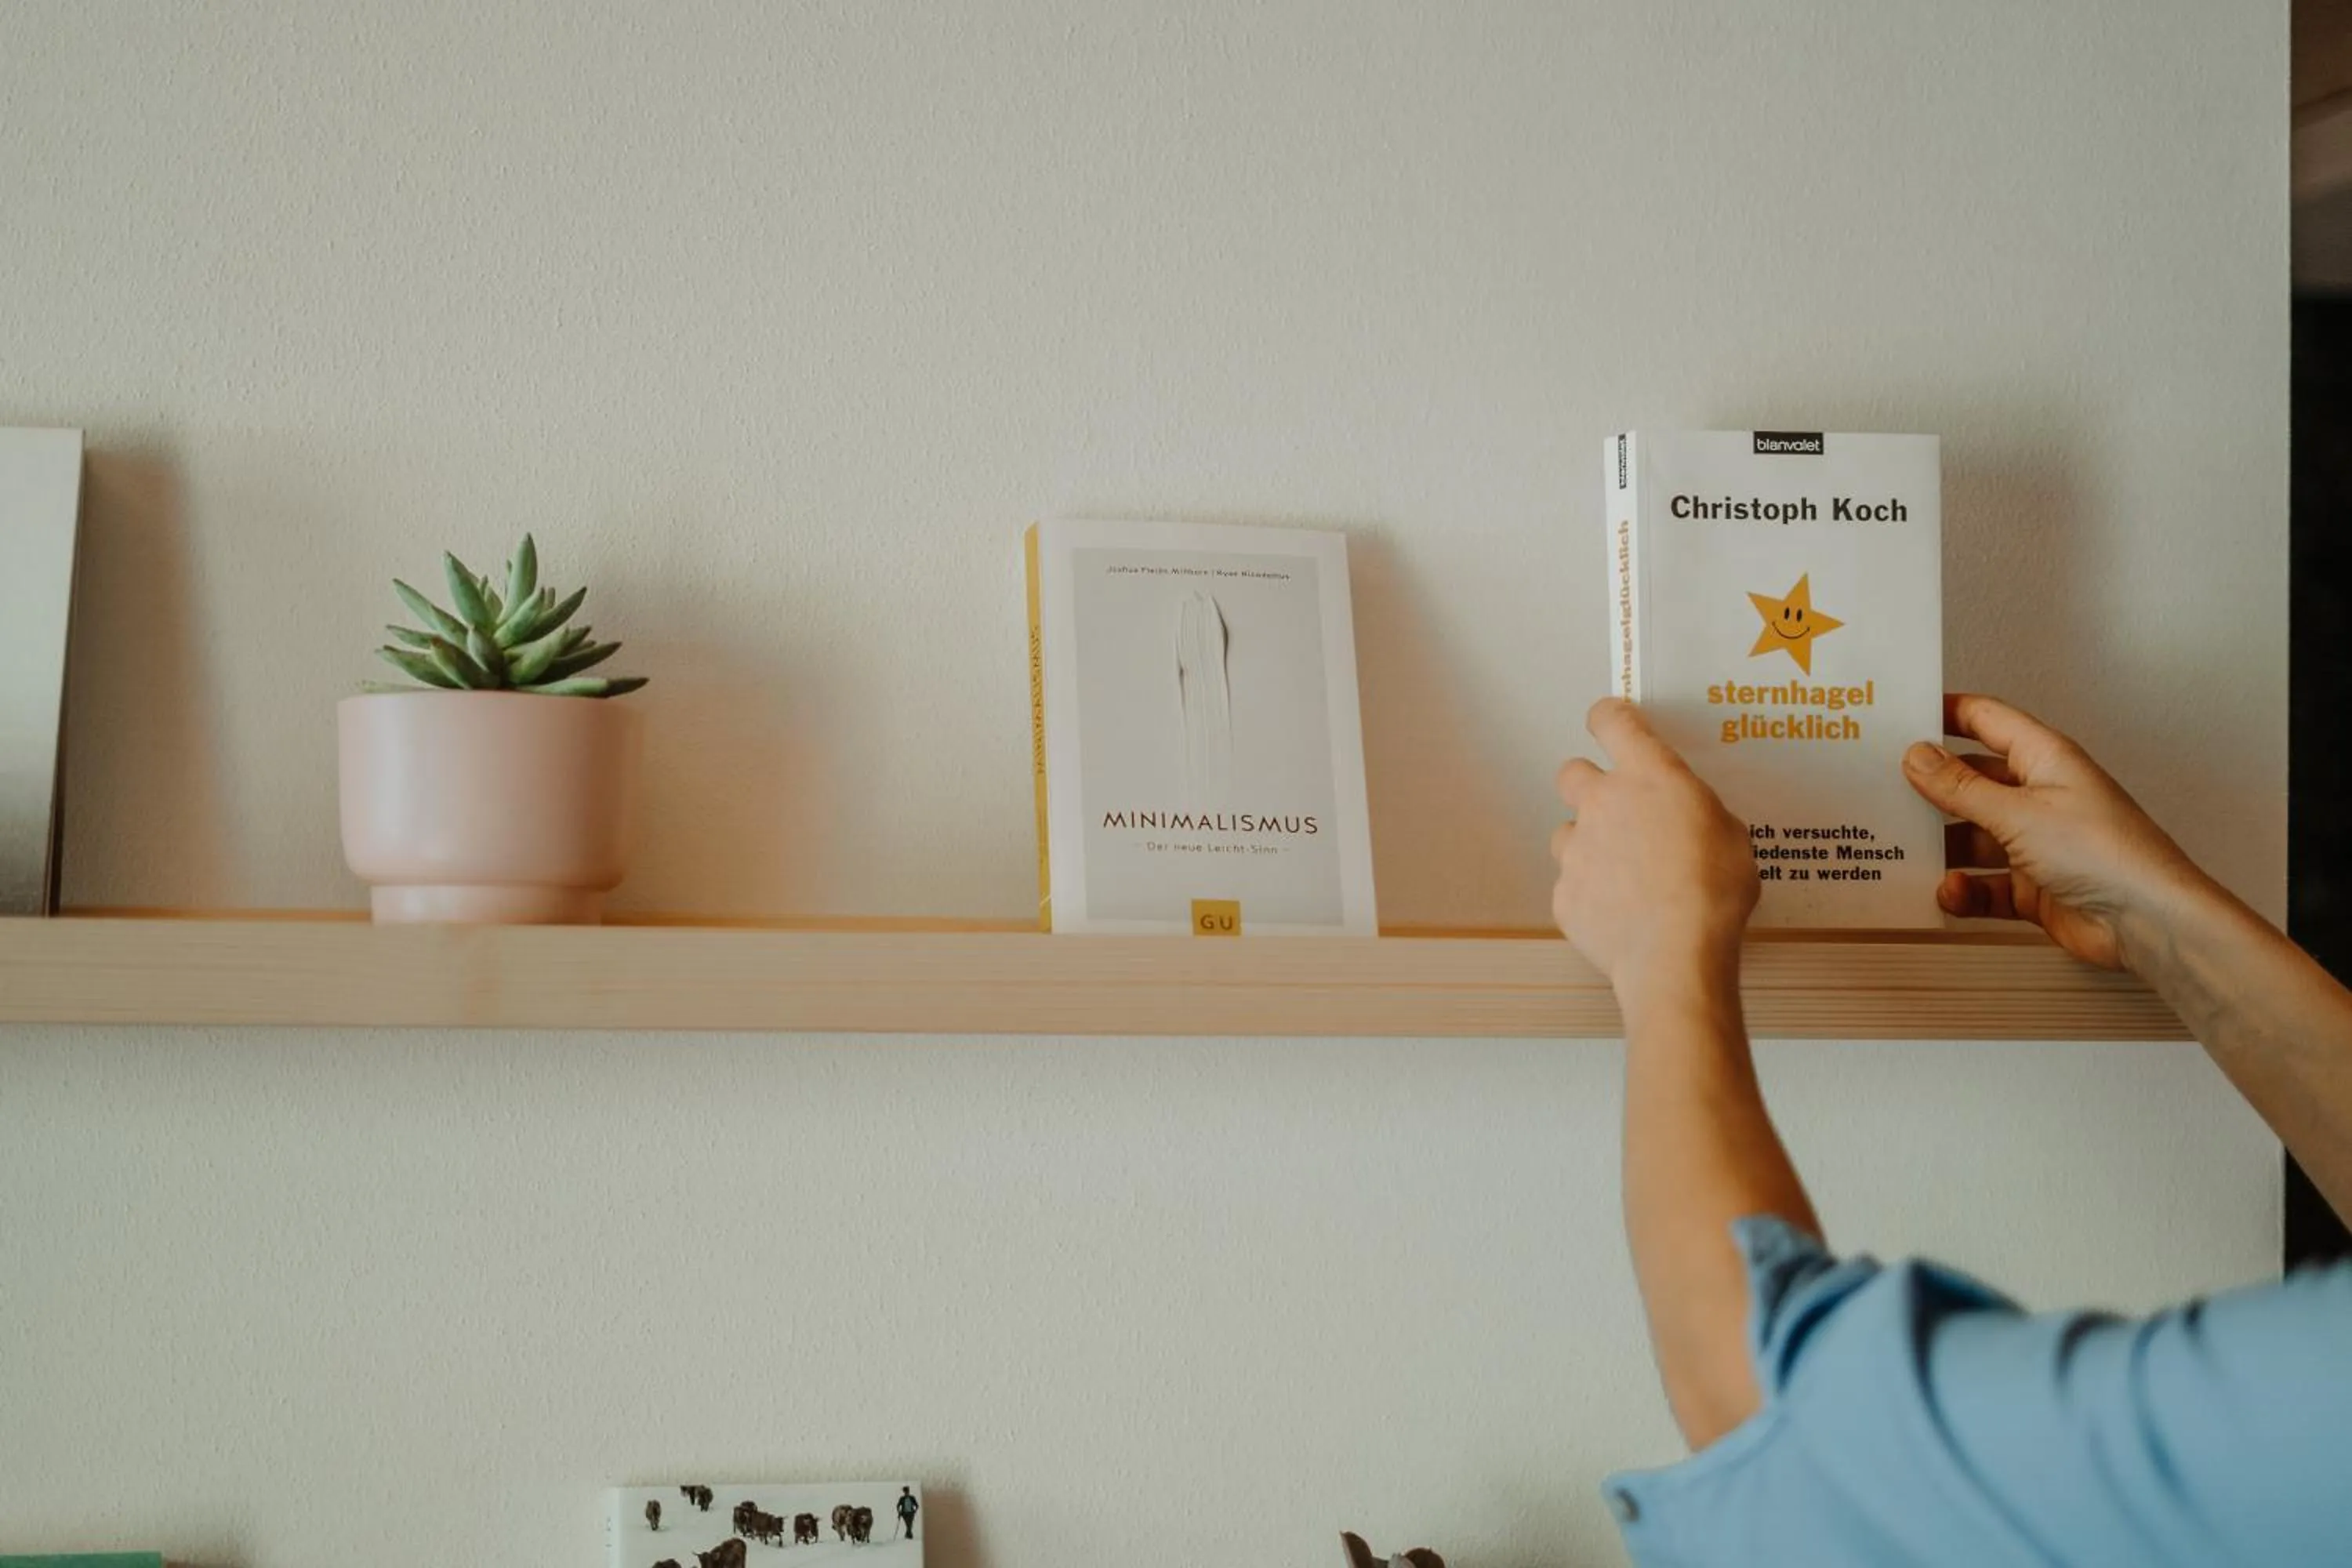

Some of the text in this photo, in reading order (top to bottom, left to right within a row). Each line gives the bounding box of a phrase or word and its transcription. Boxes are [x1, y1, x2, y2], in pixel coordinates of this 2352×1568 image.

[1756, 437, 1820, 452] blanvalet
[1670, 495, 1907, 524] Christoph Koch
[1617, 520, 1633, 703] rnhagelglücklich
[1707, 679, 1874, 710] sternhagel
[1721, 713, 1860, 742] glücklich
[1102, 811, 1319, 835] MINIMALISMUS
[1750, 824, 1875, 842] ich versuchte,
[1146, 841, 1168, 851] Der
[1174, 844, 1203, 853] neue
[1753, 844, 1904, 860] iedenste Mensch
[1757, 865, 1882, 880] elt zu werden
[1200, 913, 1234, 931] GU
